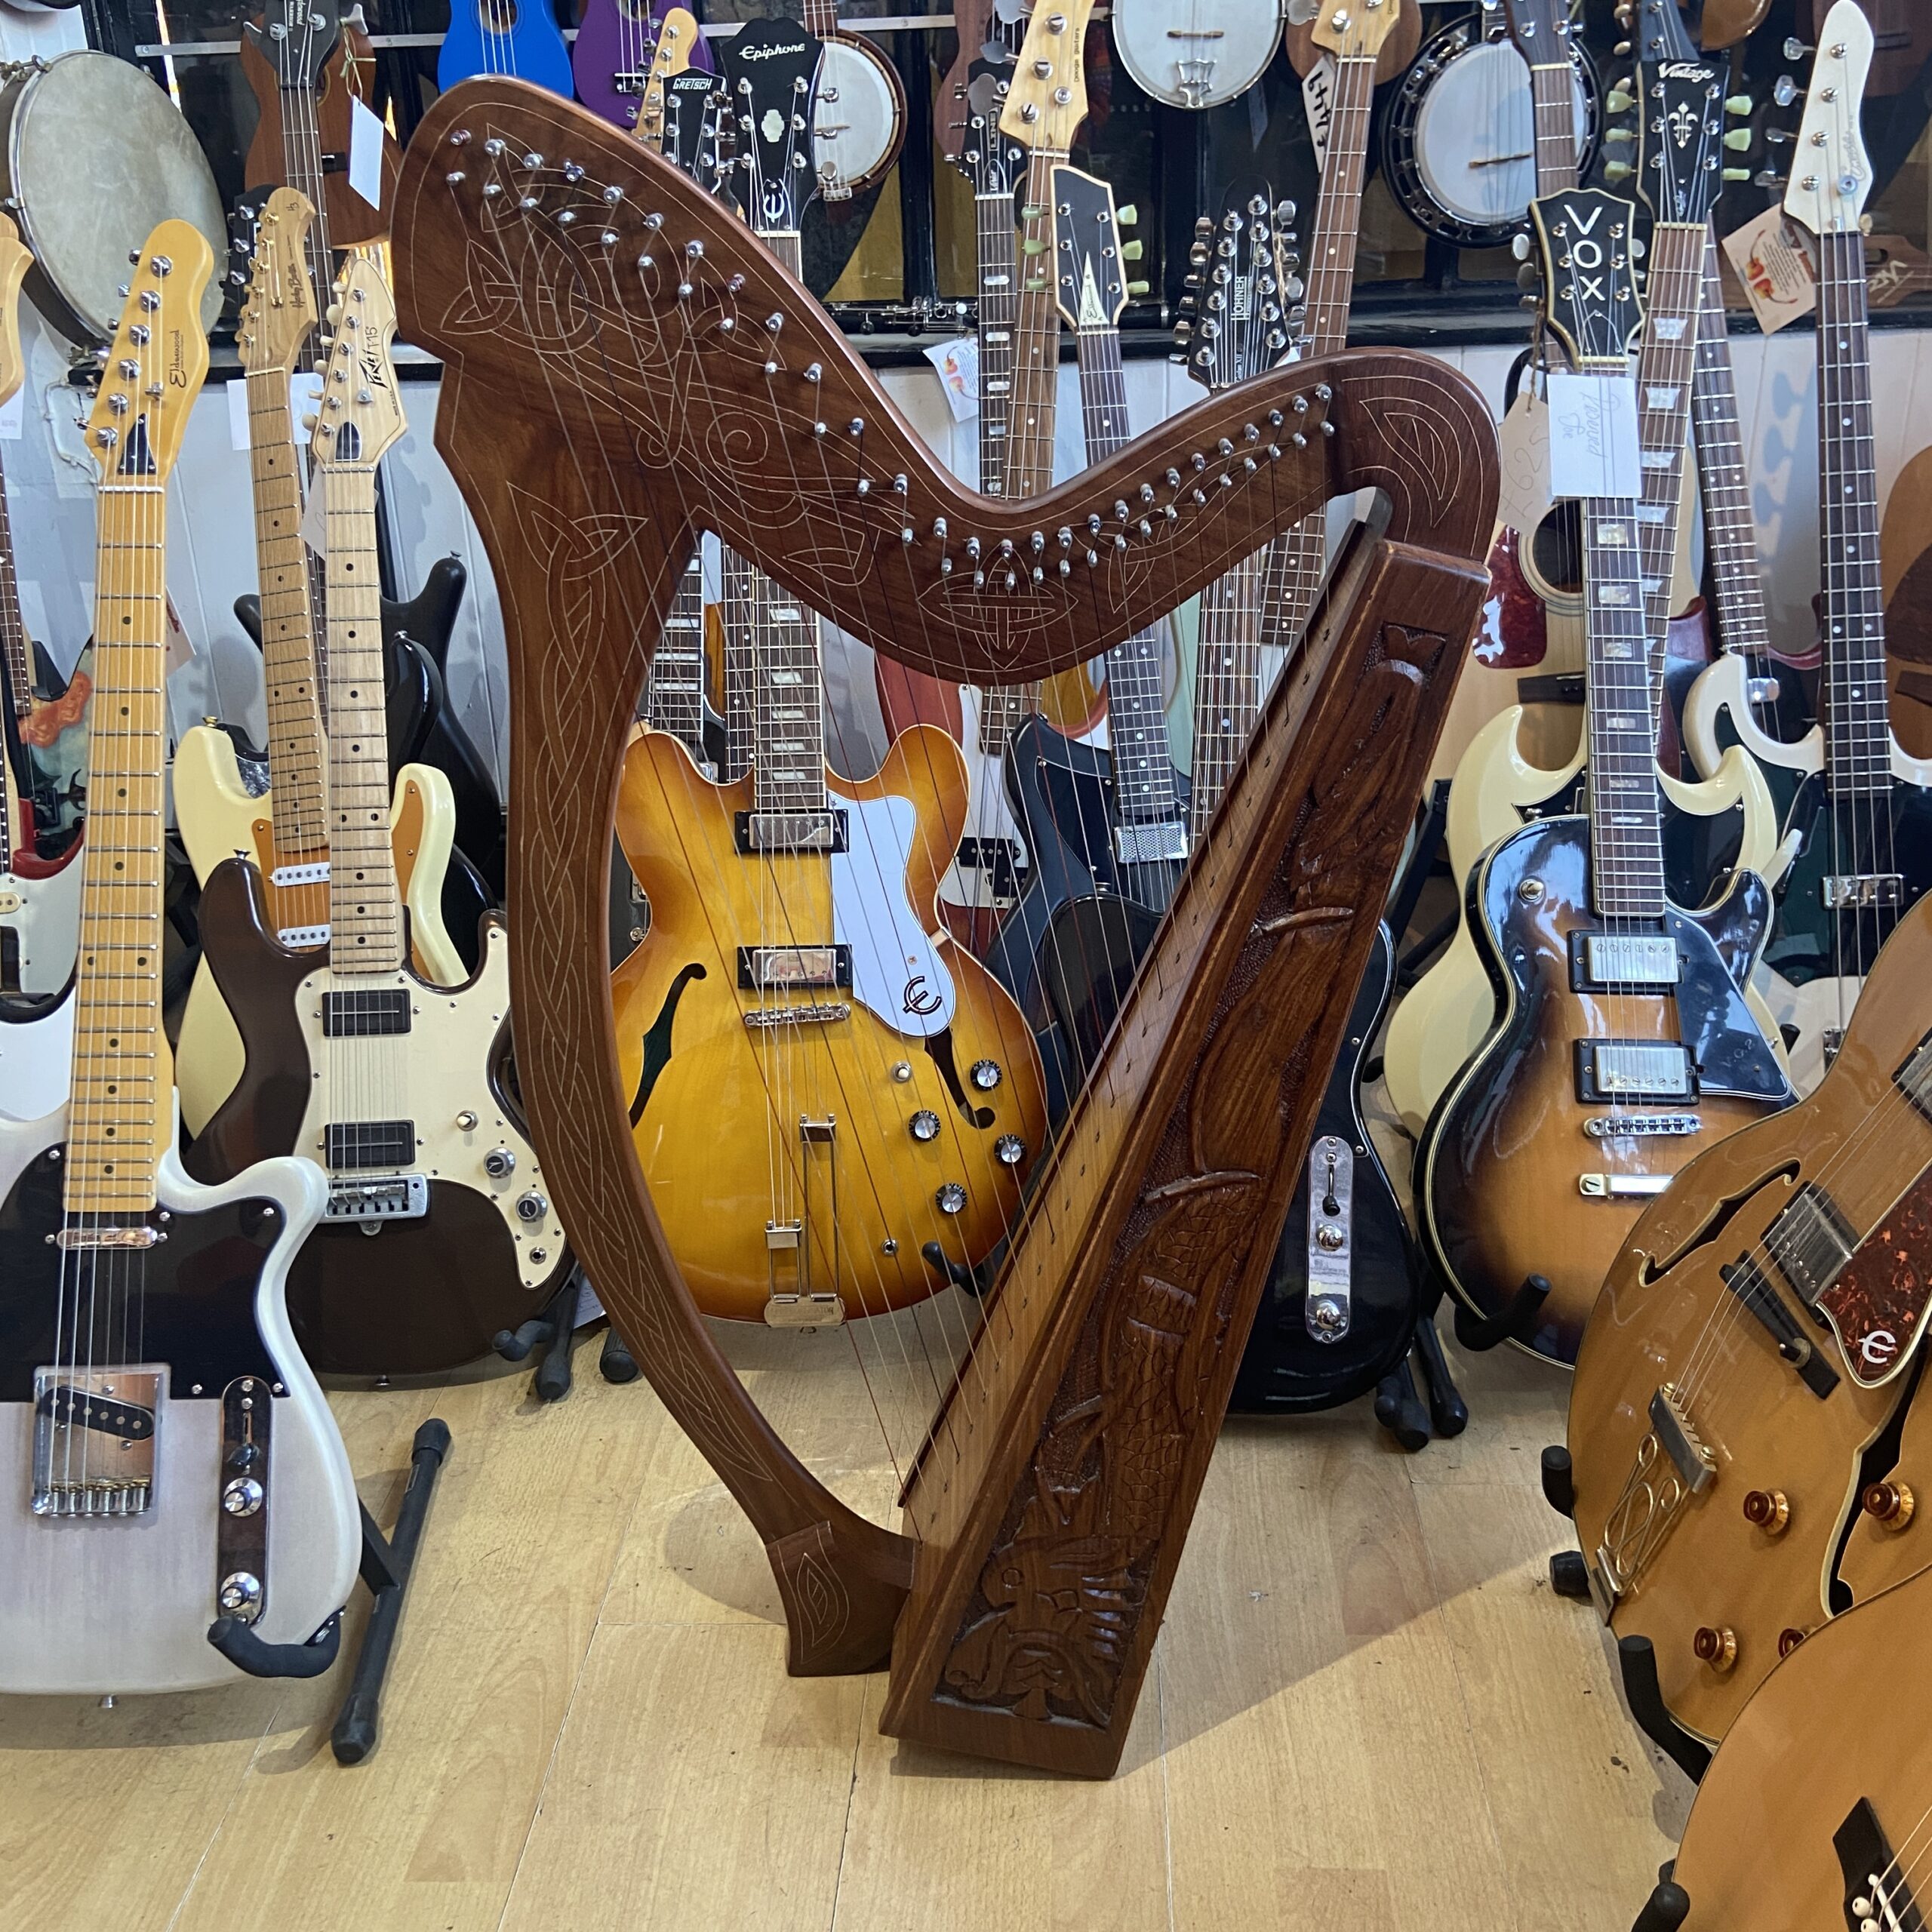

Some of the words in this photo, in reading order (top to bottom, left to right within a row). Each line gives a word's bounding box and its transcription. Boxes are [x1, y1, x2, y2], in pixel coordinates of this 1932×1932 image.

[739, 43, 805, 61] Epiphone
[1657, 62, 1715, 83] Vintage
[672, 78, 713, 91] GRETSCH
[1563, 204, 1606, 301] VOX
[1230, 275, 1251, 321] HOHNER
